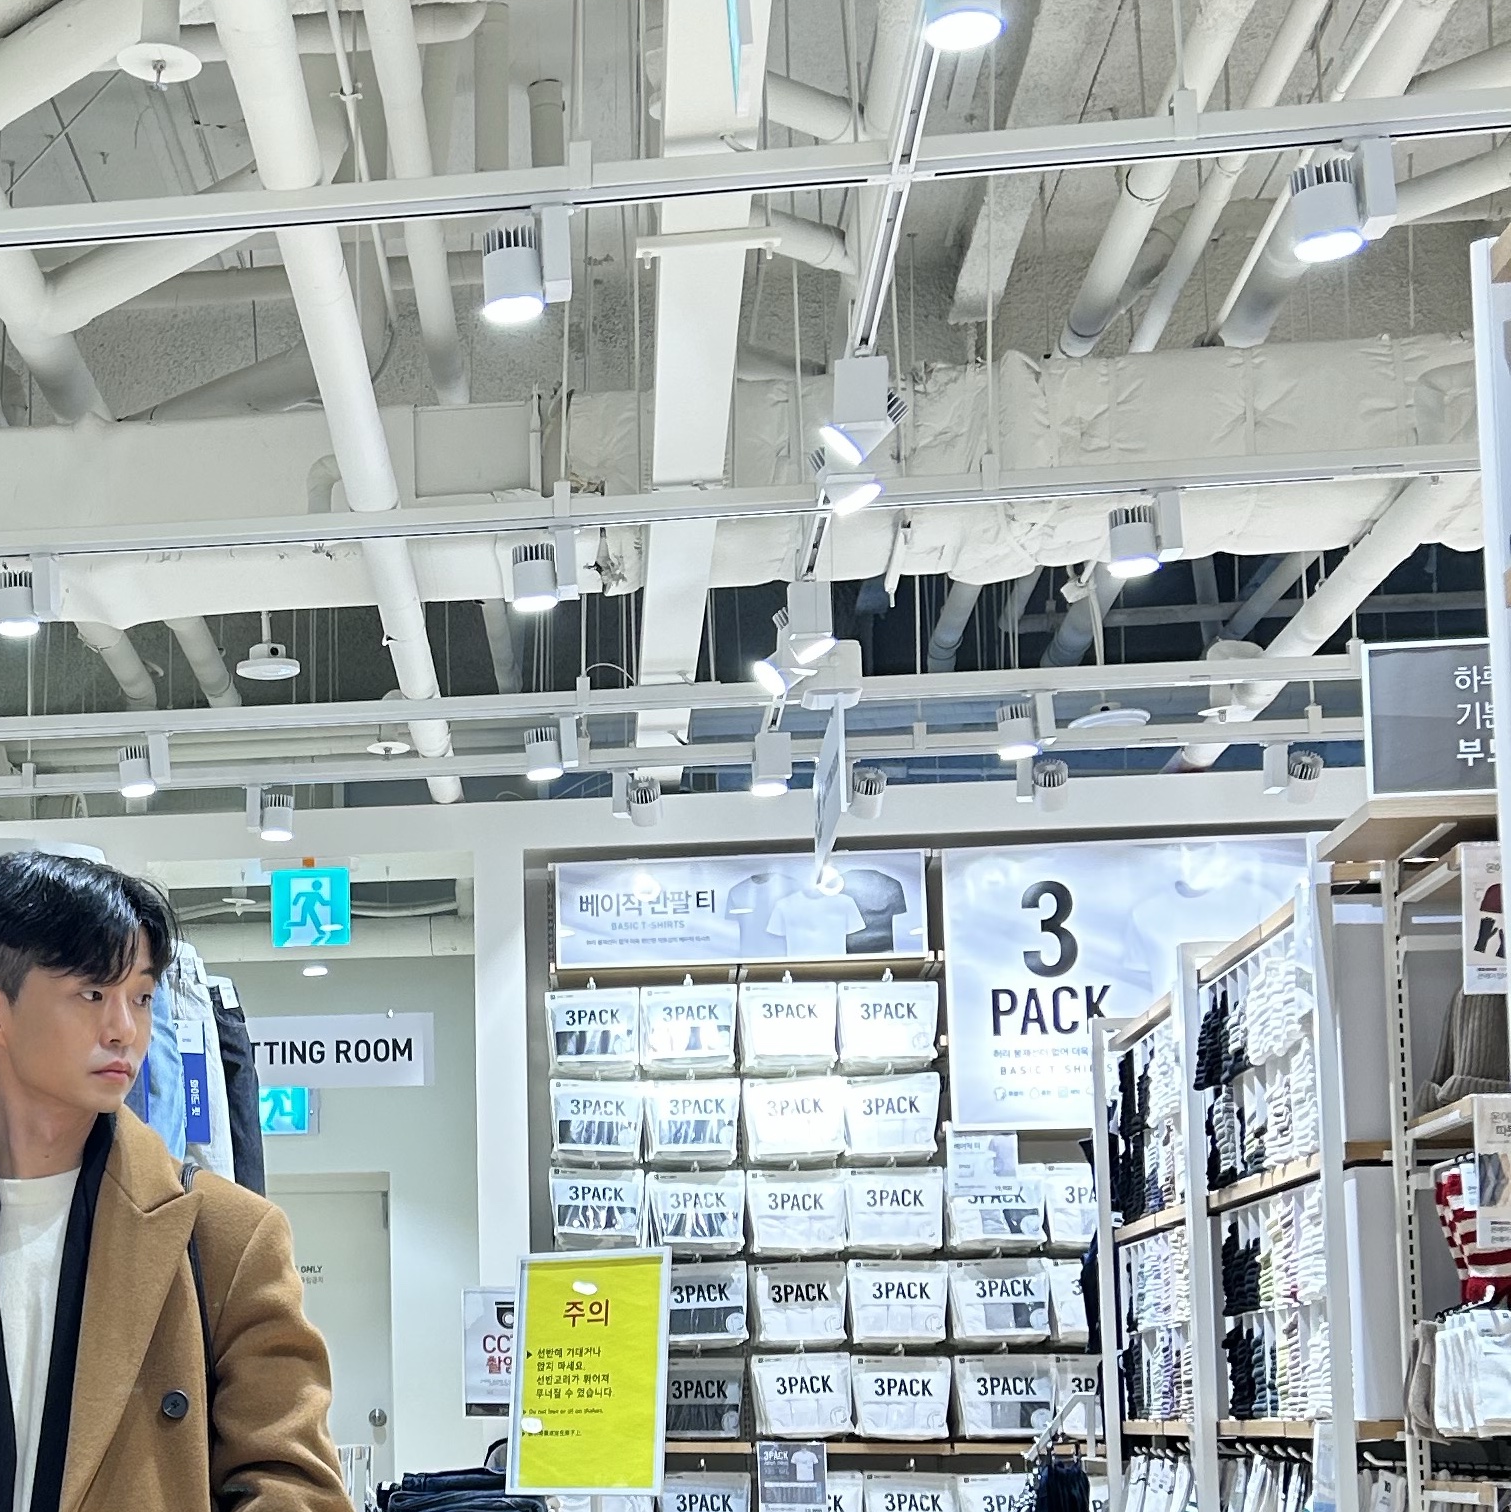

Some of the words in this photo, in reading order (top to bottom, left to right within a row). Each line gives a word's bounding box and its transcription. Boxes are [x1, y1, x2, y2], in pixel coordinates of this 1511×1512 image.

[696, 889, 715, 913] 티
[611, 921, 639, 931] BASIC
[1021, 880, 1079, 978] 3
[565, 1008, 621, 1026] 3PACK
[662, 1005, 719, 1022] 3PACK
[762, 1003, 818, 1020] 3PACK
[860, 1002, 918, 1020] 3PACK
[991, 984, 1112, 1037] PACK
[335, 1038, 413, 1063] ROOM
[1064, 1063, 1113, 1075] SHIS
[570, 1098, 625, 1117] 3PACK
[669, 1097, 726, 1116] 3PACK
[767, 1097, 824, 1117] 3PACK
[862, 1095, 921, 1116] 3PACK
[568, 1185, 624, 1203] 3PACK
[670, 1192, 727, 1209] 3PACK
[768, 1192, 824, 1211] 3PACK
[866, 1189, 925, 1208] 3PACK
[301, 1265, 323, 1274] ONLY
[672, 1283, 730, 1304] 3PACK
[771, 1283, 829, 1303] 3PACK
[873, 1281, 930, 1300] 3PACK
[975, 1278, 1035, 1299] 3PACK
[563, 1299, 610, 1327] 주의
[483, 1334, 513, 1354] CC
[566, 1346, 601, 1358] 기대거나
[564, 1388, 574, 1399] 수
[672, 1380, 728, 1399] 3PACK
[776, 1375, 834, 1395] 3PACK
[874, 1377, 933, 1397] 3PACK
[977, 1376, 1036, 1396] 3PACK
[676, 1494, 733, 1512] 3PACK
[885, 1493, 943, 1512] 3PACK
